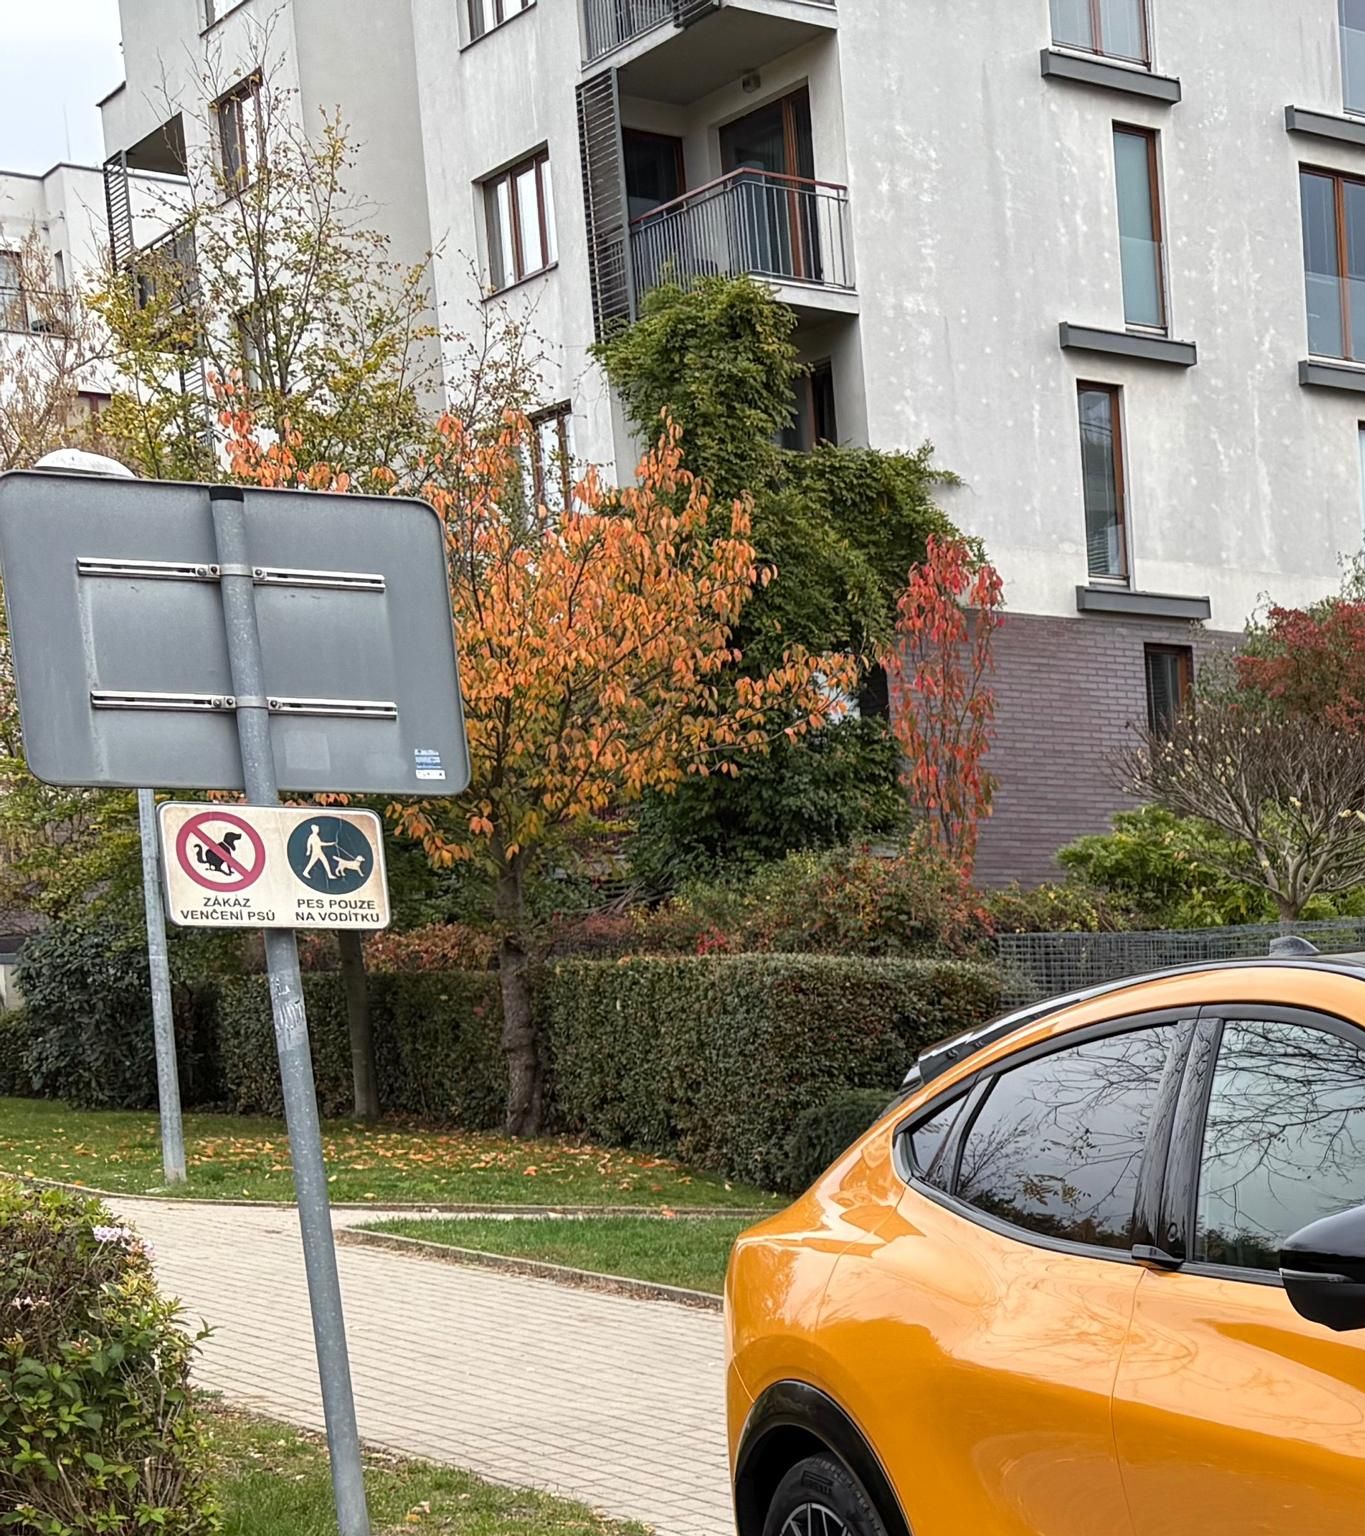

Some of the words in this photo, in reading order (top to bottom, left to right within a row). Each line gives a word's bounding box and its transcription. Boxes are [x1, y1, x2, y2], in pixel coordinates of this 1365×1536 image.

[297, 898, 325, 909] PES
[328, 899, 376, 910] POUZE
[180, 908, 244, 921] VENČENÍ
[295, 911, 316, 921] NA
[318, 910, 380, 923] VODÍTKU
